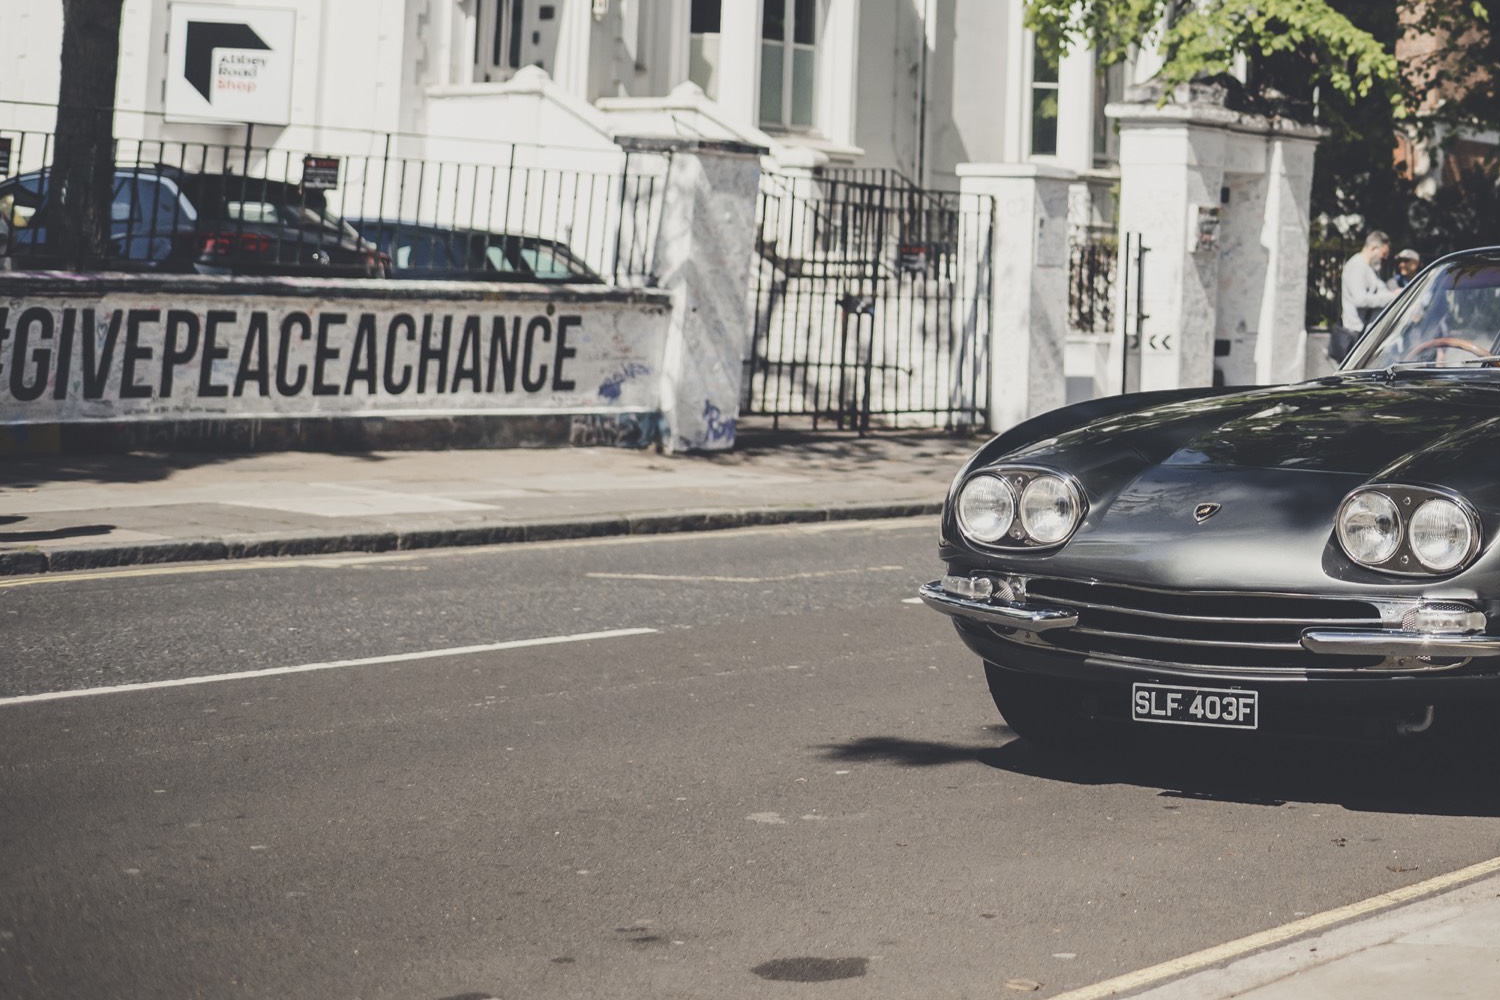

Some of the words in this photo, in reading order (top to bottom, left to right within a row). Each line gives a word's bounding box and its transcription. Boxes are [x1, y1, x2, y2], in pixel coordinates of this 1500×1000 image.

[220, 54, 267, 67] Abbey
[218, 65, 257, 77] Road
[217, 80, 257, 93] Shop
[1135, 691, 1182, 716] SLF
[1189, 695, 1255, 721] 403F
